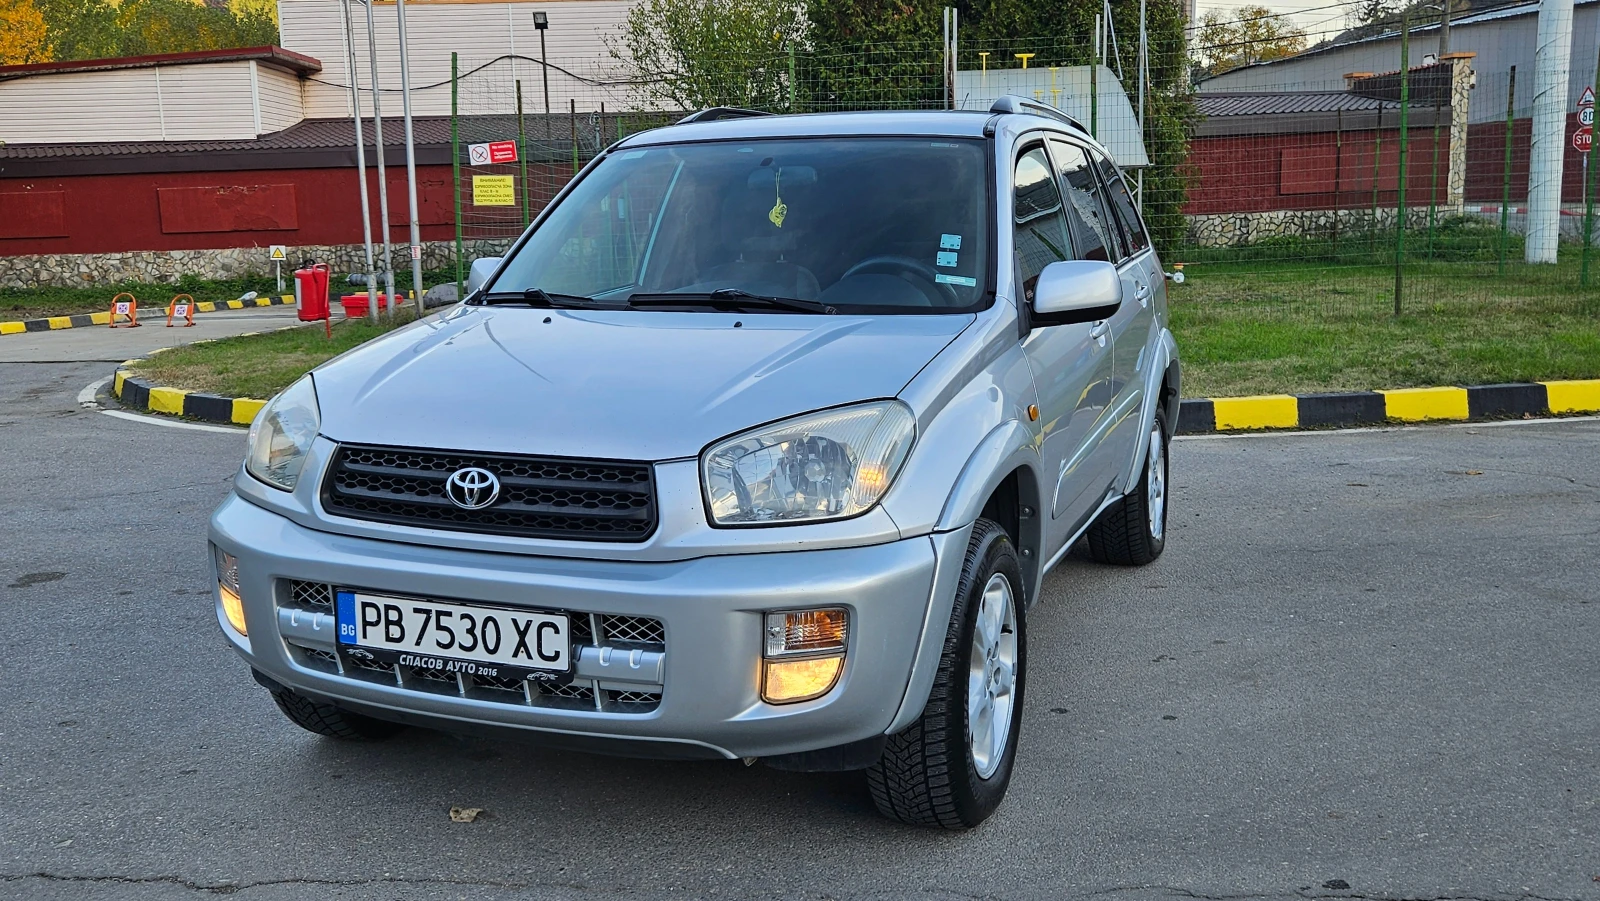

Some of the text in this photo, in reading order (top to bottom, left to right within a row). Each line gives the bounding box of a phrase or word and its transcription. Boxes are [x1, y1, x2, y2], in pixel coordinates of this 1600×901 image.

[1582, 111, 1594, 122] 80
[1576, 134, 1592, 145] STO
[341, 623, 355, 636] BG
[361, 601, 561, 662] PB 7530 XC
[399, 654, 498, 676] СПАСОВ АУТО 2016
